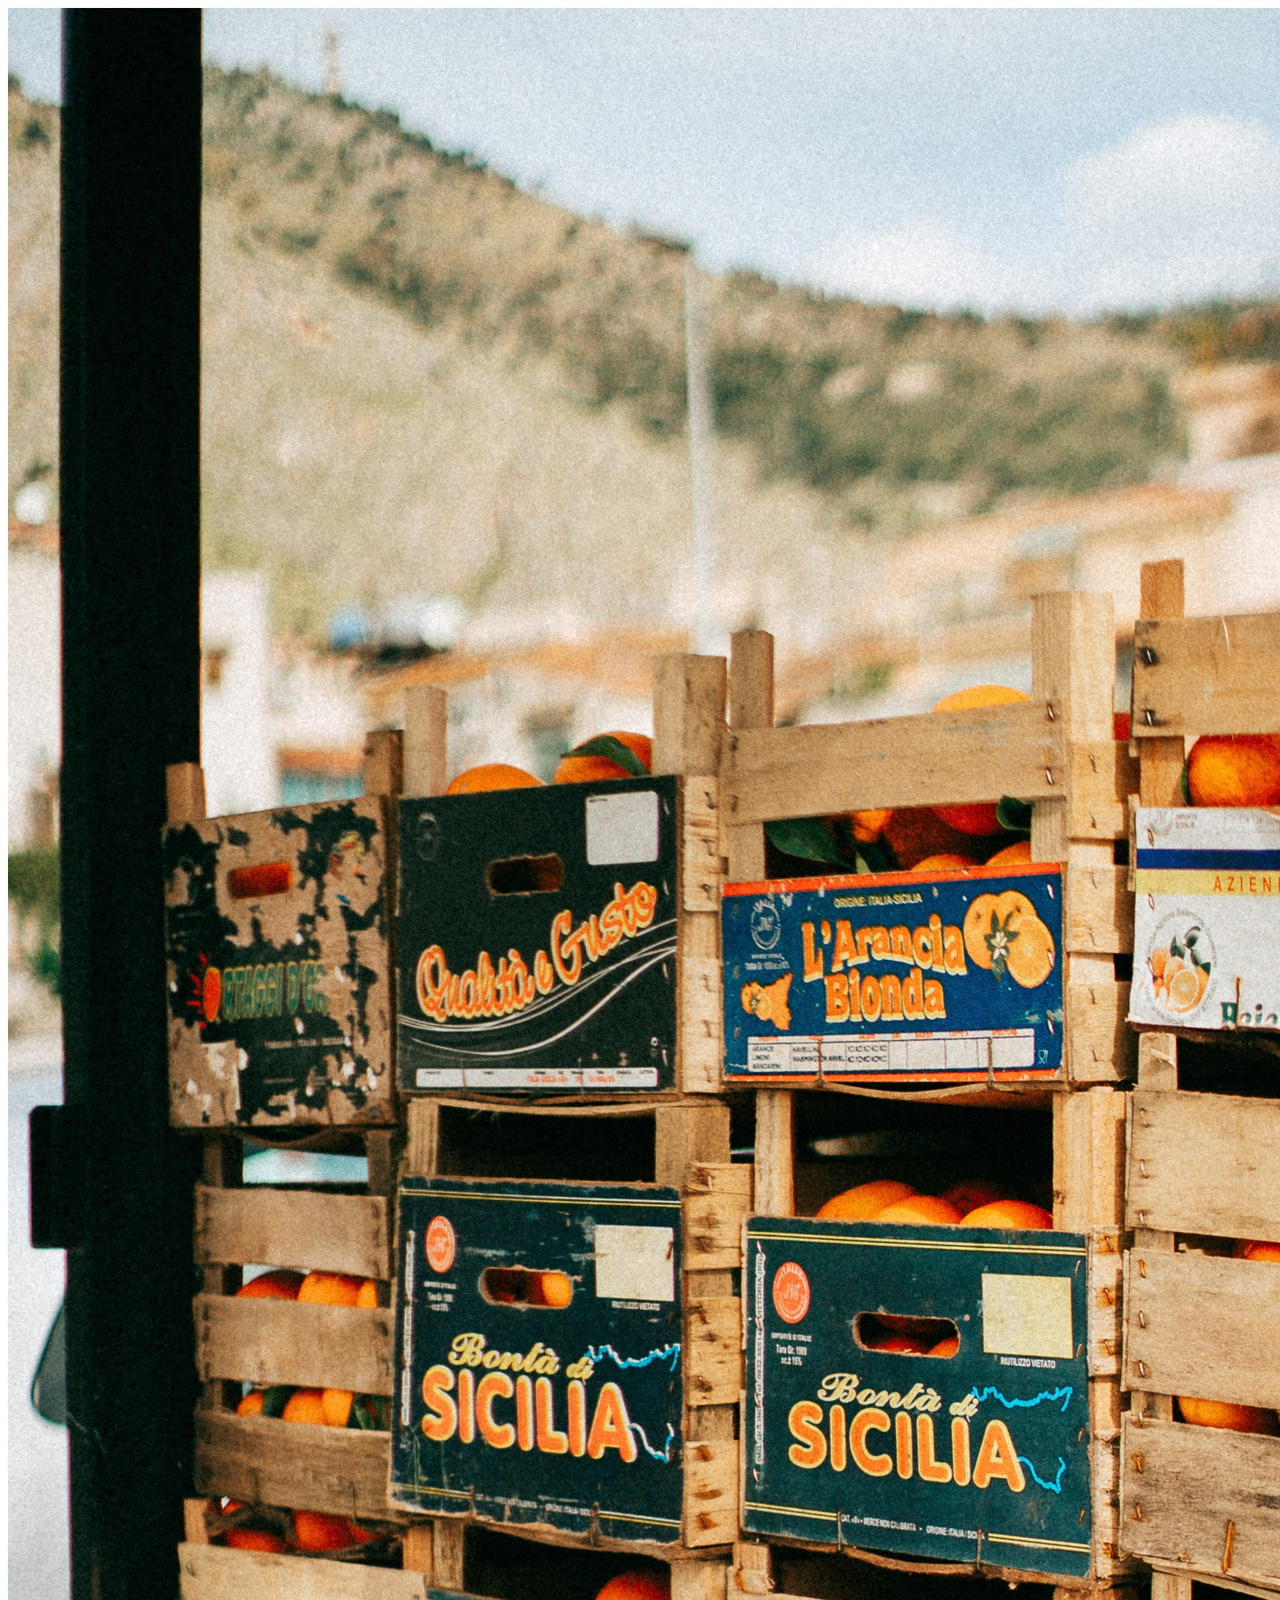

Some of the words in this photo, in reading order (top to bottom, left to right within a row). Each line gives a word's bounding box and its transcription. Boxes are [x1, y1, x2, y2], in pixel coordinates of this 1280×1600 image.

[415, 944, 536, 1022] Qualità
[533, 949, 553, 995] e
[551, 881, 657, 986] Gusto
[801, 912, 968, 983] L'Arancia
[824, 967, 947, 1023] Bionda
[447, 1332, 561, 1376] Bontà
[420, 1364, 638, 1464] SICILIA
[816, 1372, 943, 1413] Bontà
[948, 1392, 979, 1422] di
[787, 1400, 1027, 1493] SICILIA
